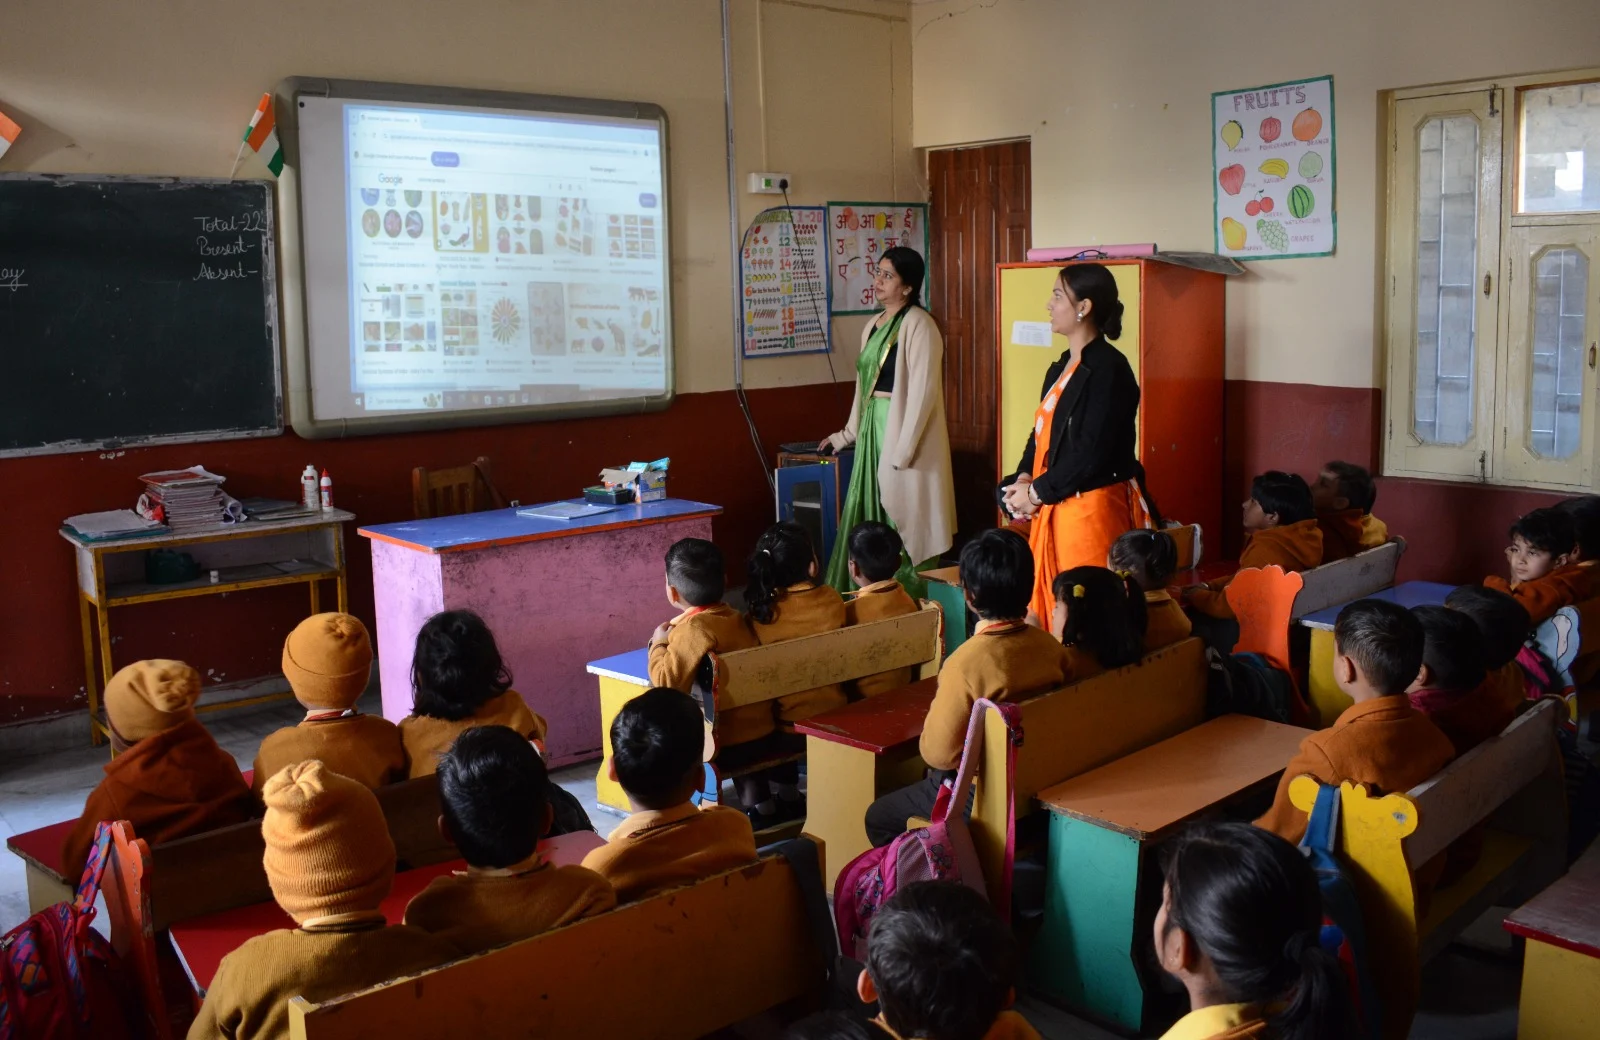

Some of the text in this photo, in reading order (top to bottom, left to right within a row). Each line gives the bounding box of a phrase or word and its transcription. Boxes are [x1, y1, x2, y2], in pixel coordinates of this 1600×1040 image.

[1232, 85, 1307, 112] FRUITS
[378, 173, 403, 186] Google
[753, 210, 794, 224] NUMBERS
[836, 214, 848, 229] अ
[860, 214, 875, 229] आ
[778, 224, 790, 236] 11
[779, 237, 791, 247] 12
[1290, 235, 1314, 243] GRAPES
[836, 238, 845, 255] उ
[867, 237, 878, 253] ऊ
[744, 247, 751, 259] 3
[779, 248, 791, 258] 13
[744, 260, 751, 272] 4
[779, 258, 791, 271] 14
[780, 272, 792, 283] 15
[838, 264, 849, 281] ए
[744, 274, 752, 285] 5
[745, 286, 753, 297] 6
[780, 283, 793, 295] 16
[745, 298, 752, 310] 7
[781, 295, 794, 307] 17
[781, 307, 795, 321] 18
[747, 325, 754, 337] 9
[782, 321, 796, 335] 19
[746, 339, 757, 351] 10
[782, 336, 796, 349] 20
